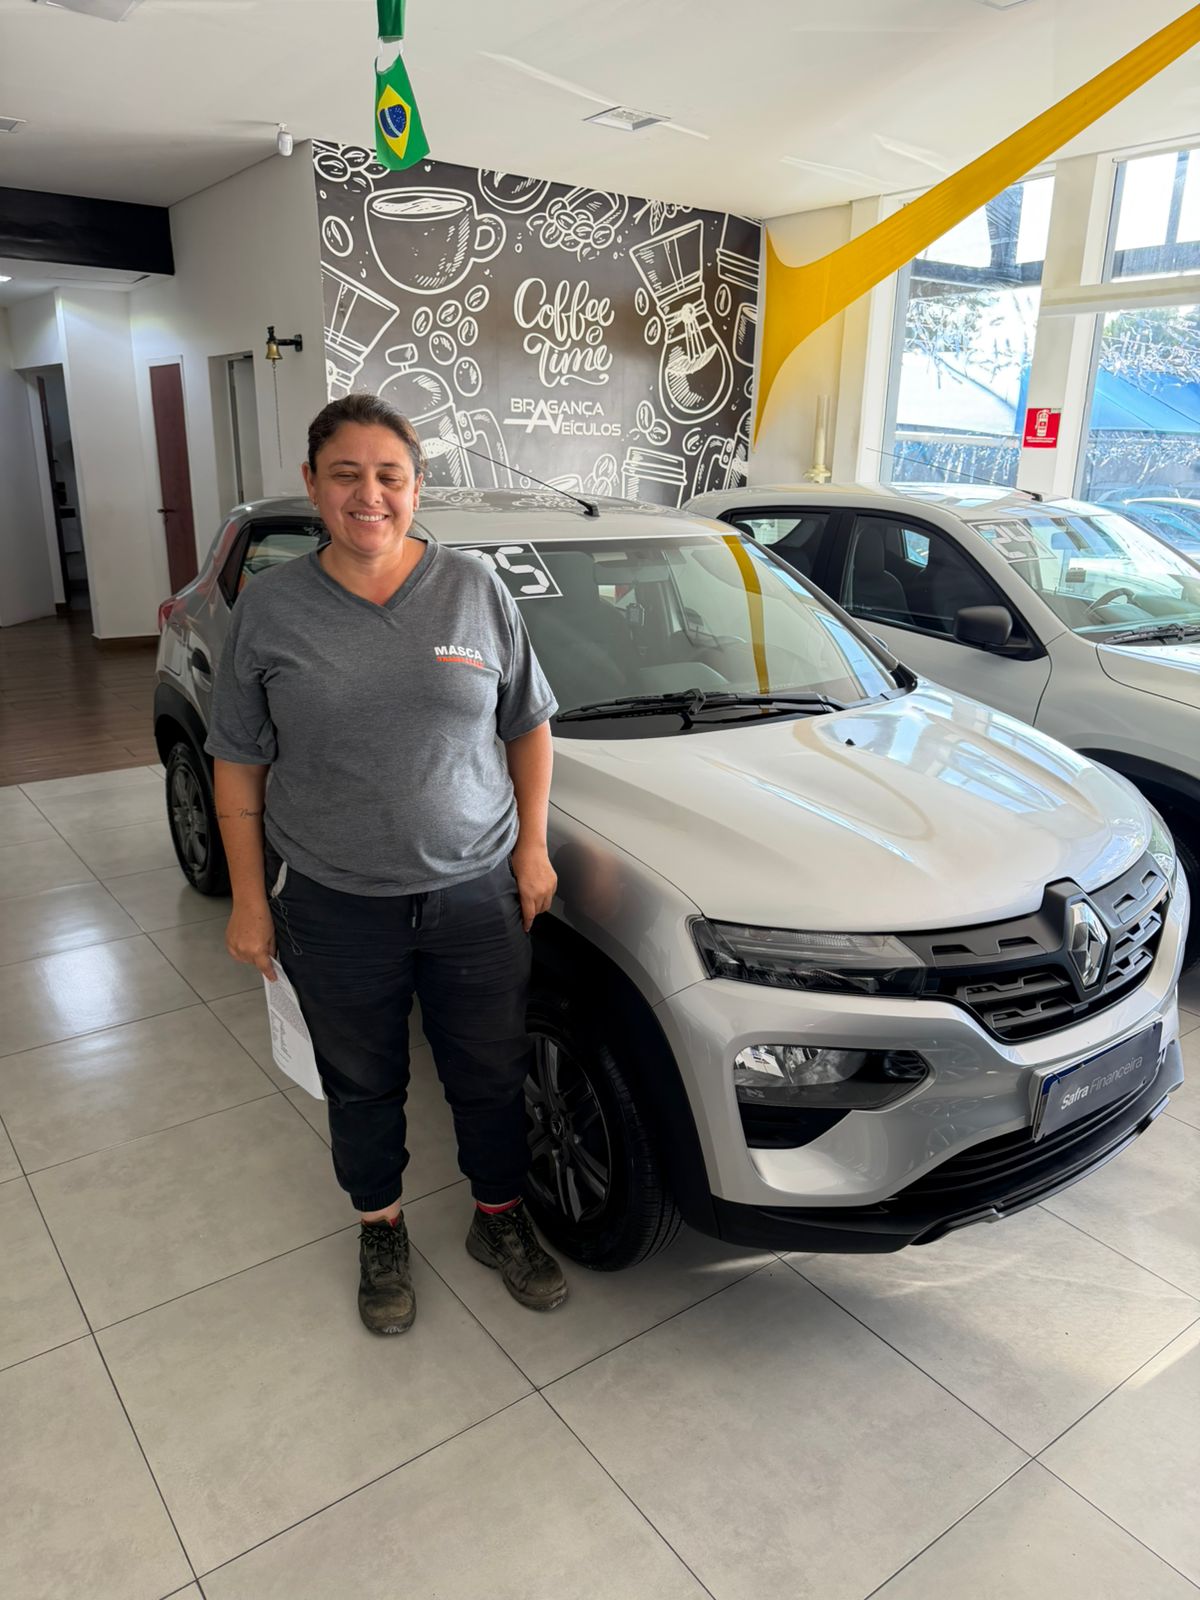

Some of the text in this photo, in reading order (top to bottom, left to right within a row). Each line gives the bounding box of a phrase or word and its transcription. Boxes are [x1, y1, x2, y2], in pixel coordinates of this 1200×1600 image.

[514, 277, 614, 341] Coffee
[523, 332, 613, 387] Time
[511, 398, 604, 424] BRAGANÇA
[434, 645, 483, 661] MASCA
[1060, 1056, 1144, 1110] Safra Financeira
